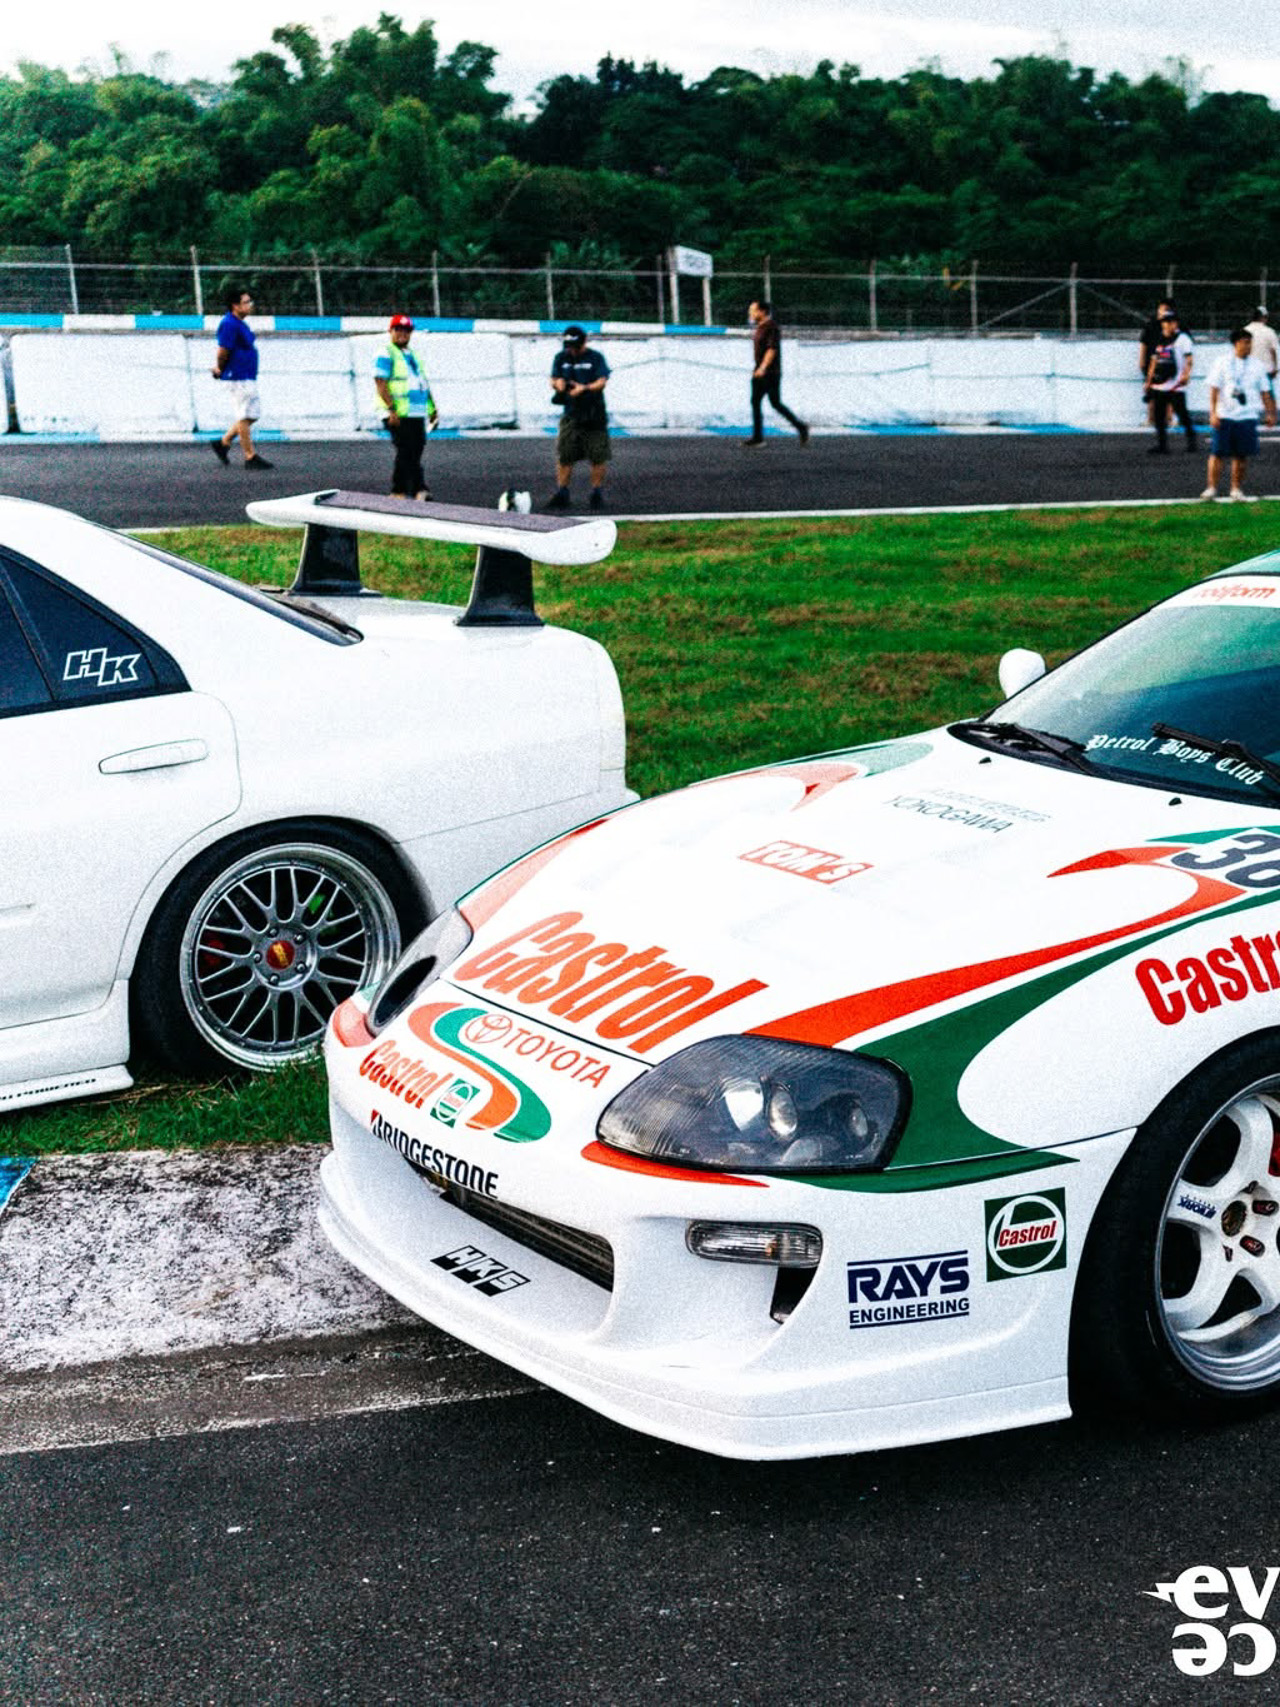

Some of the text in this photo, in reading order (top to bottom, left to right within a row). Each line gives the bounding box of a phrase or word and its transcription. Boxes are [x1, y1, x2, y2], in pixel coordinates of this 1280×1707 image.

[1215, 756, 1265, 786] Club
[739, 840, 871, 883] TOM'S
[453, 911, 769, 1053] Castrol
[358, 1038, 454, 1109] Castrol
[504, 1025, 612, 1089] TOYOTA
[369, 1108, 499, 1200] BRIDGESTONE
[999, 1220, 1058, 1248] Castrol
[432, 1245, 530, 1295] HKS
[847, 1257, 970, 1304] RAYS
[848, 1299, 970, 1324] ENGINEERING
